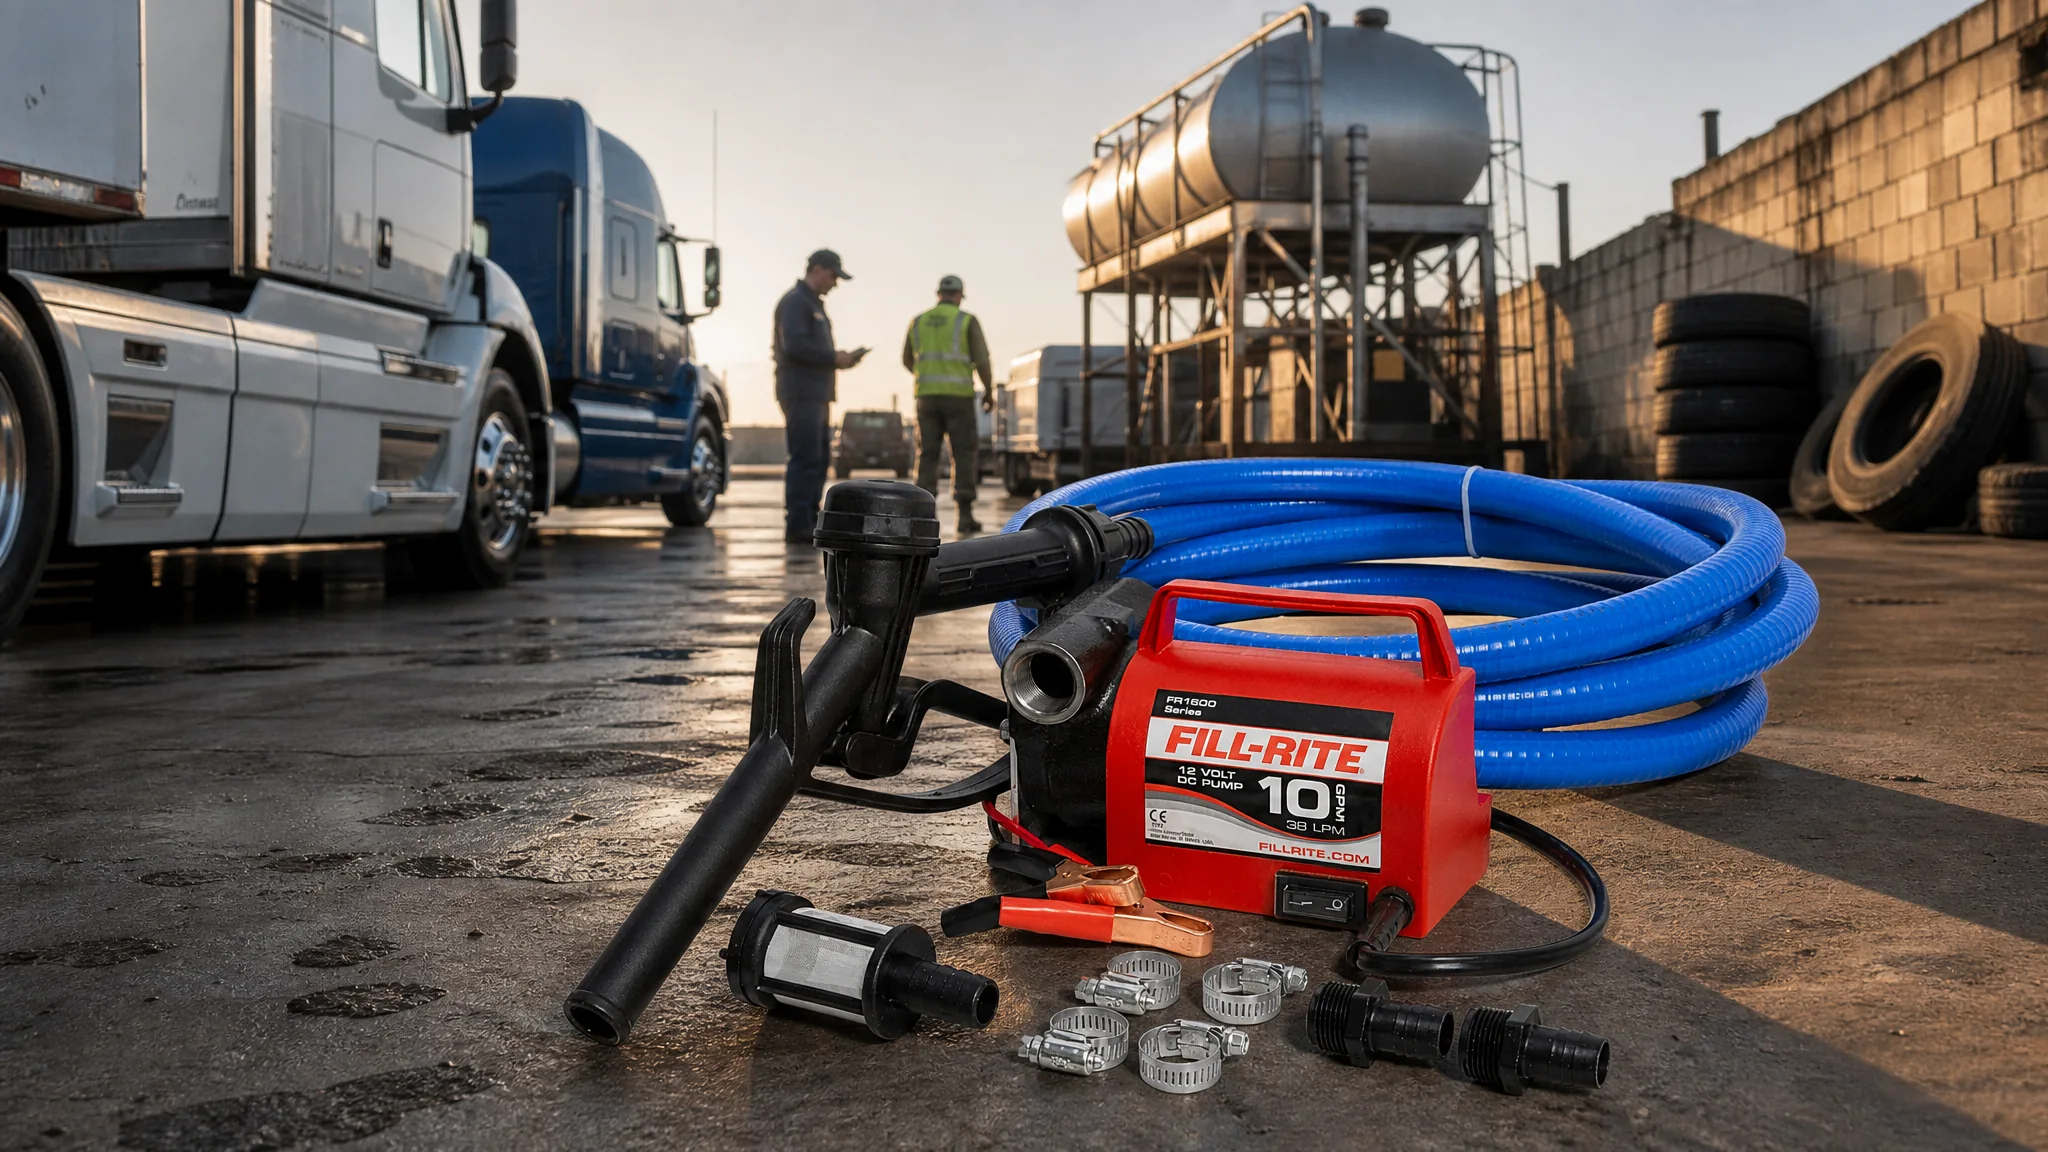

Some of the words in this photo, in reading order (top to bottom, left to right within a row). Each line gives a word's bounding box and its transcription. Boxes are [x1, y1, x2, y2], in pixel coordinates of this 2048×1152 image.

[1166, 696, 1217, 708] FR1600
[1179, 765, 1196, 775] 12
[1200, 768, 1236, 779] VOLT
[1177, 775, 1197, 785] DC
[1201, 779, 1243, 790] PUMP
[1258, 776, 1330, 819] 10
[1335, 784, 1346, 822] GPM
[1286, 820, 1307, 831] 38
[1313, 823, 1345, 836] LPM
[1259, 842, 1370, 864] FILLRITE.COM
